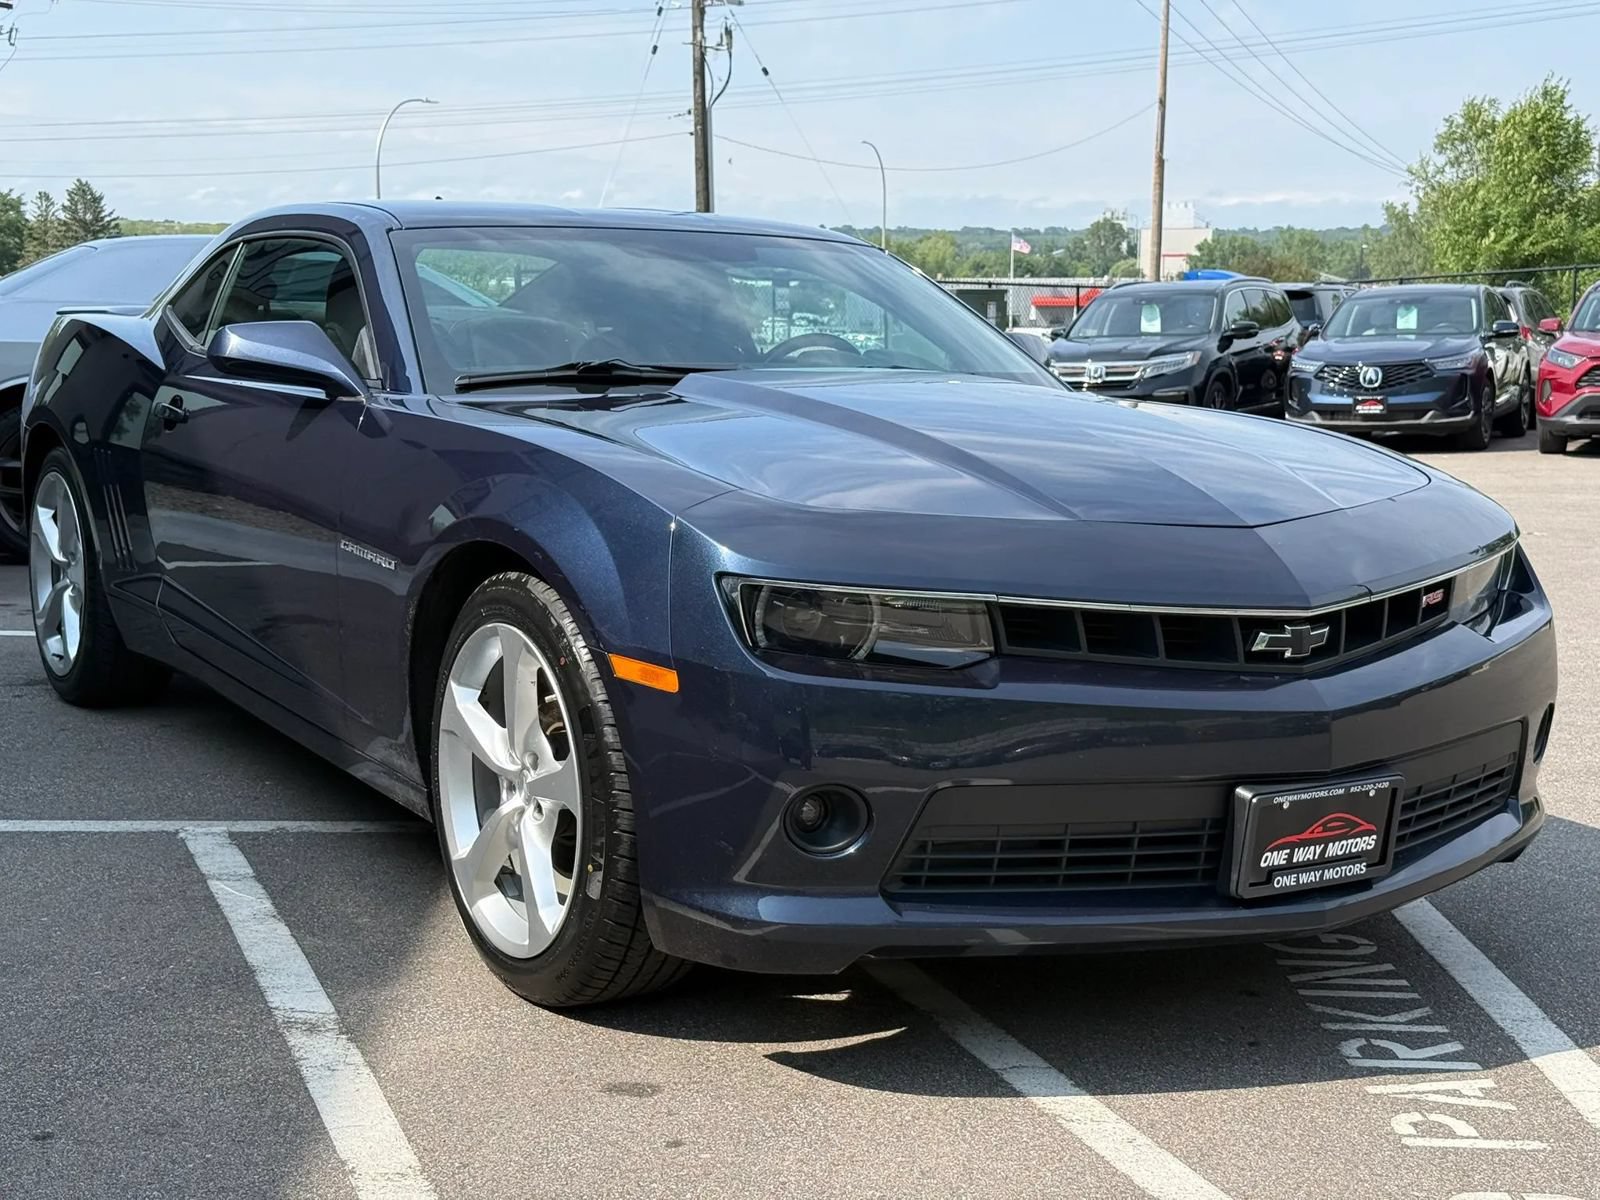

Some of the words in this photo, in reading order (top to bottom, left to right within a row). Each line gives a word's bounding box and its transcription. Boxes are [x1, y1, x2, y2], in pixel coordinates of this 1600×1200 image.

[340, 539, 396, 570] CAMARO
[1422, 588, 1444, 608] RS
[1273, 788, 1345, 804] ONEWAYMOTORS.COM
[1260, 849, 1290, 868] ONE
[1292, 844, 1325, 863] WAY
[1324, 835, 1377, 858] MOTORS
[1273, 874, 1297, 888] ONE
[1299, 869, 1322, 885] WAY
[1323, 862, 1367, 881] MOTORS
[1264, 933, 1552, 1151] PARKING
